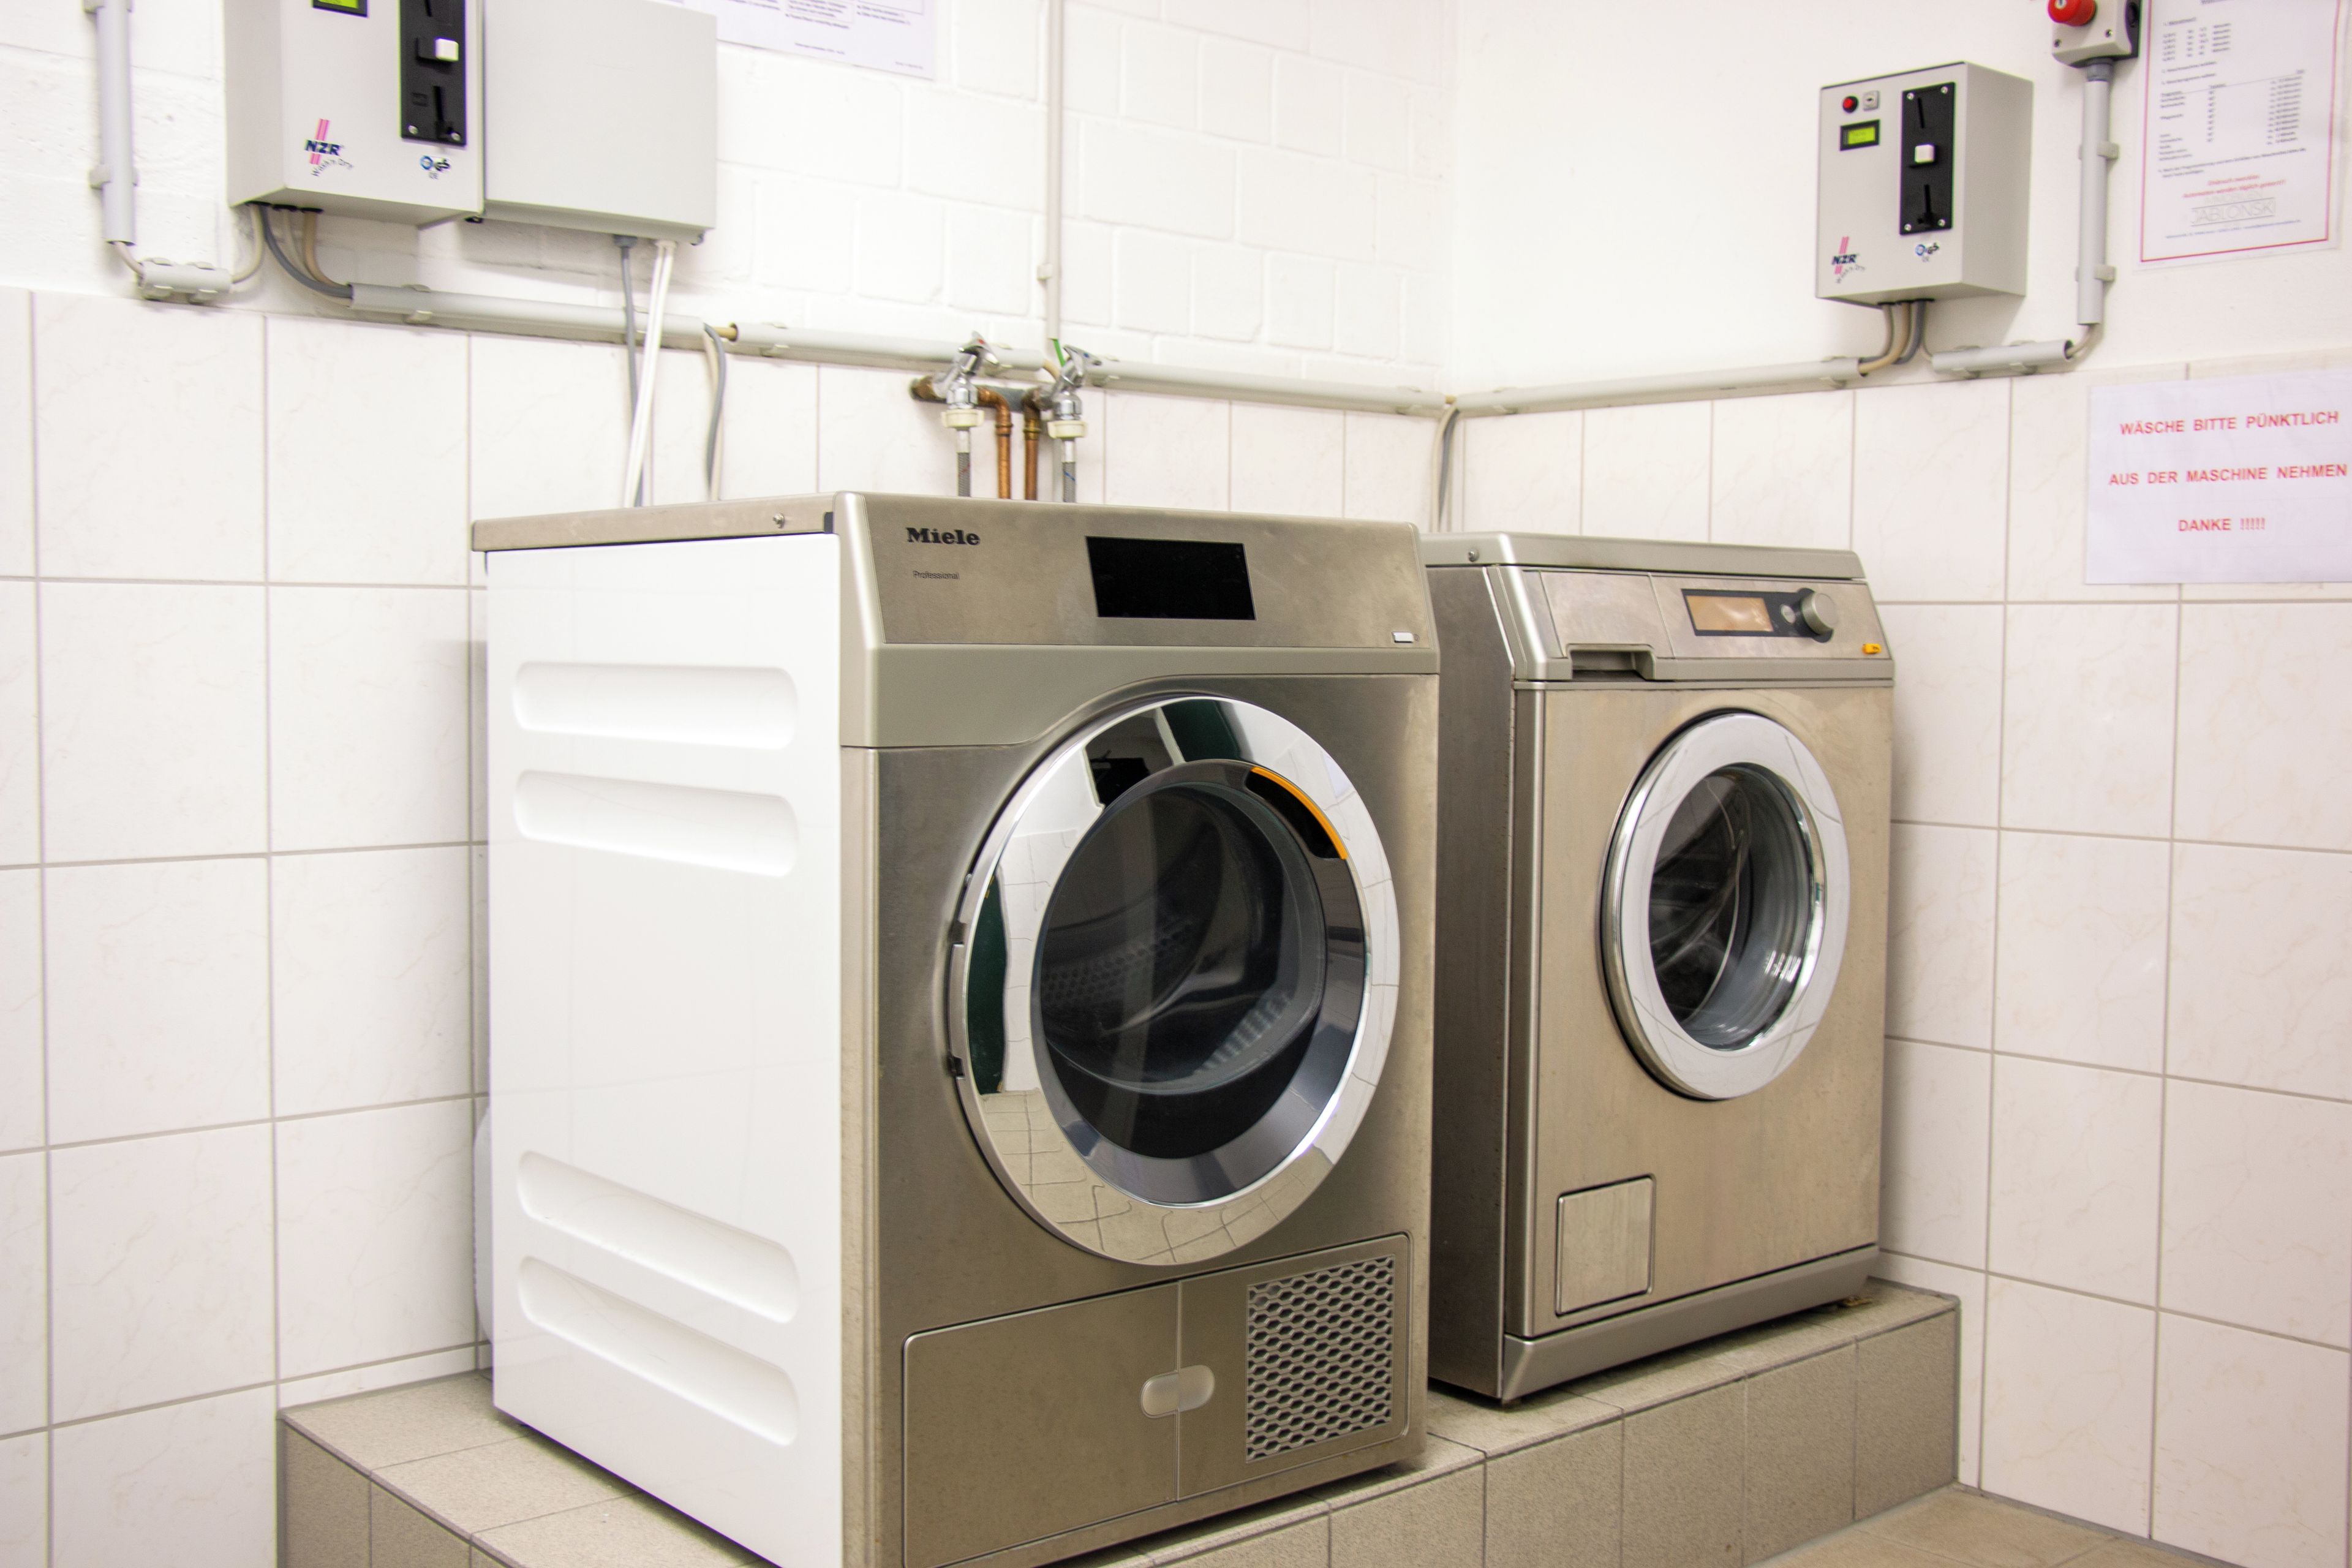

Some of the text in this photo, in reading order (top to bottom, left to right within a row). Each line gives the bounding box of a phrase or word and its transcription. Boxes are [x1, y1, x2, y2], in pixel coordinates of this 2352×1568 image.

[305, 139, 341, 156] NZR
[1831, 254, 1858, 265] NZR
[2120, 411, 2339, 435] WÄSCHE BITTE PÜNKTLICH
[2108, 464, 2347, 486] AUS DER MASCHINE NEHMEN
[2177, 518, 2231, 532] DANKE
[906, 527, 980, 546] Miele
[912, 570, 960, 580] Professional
